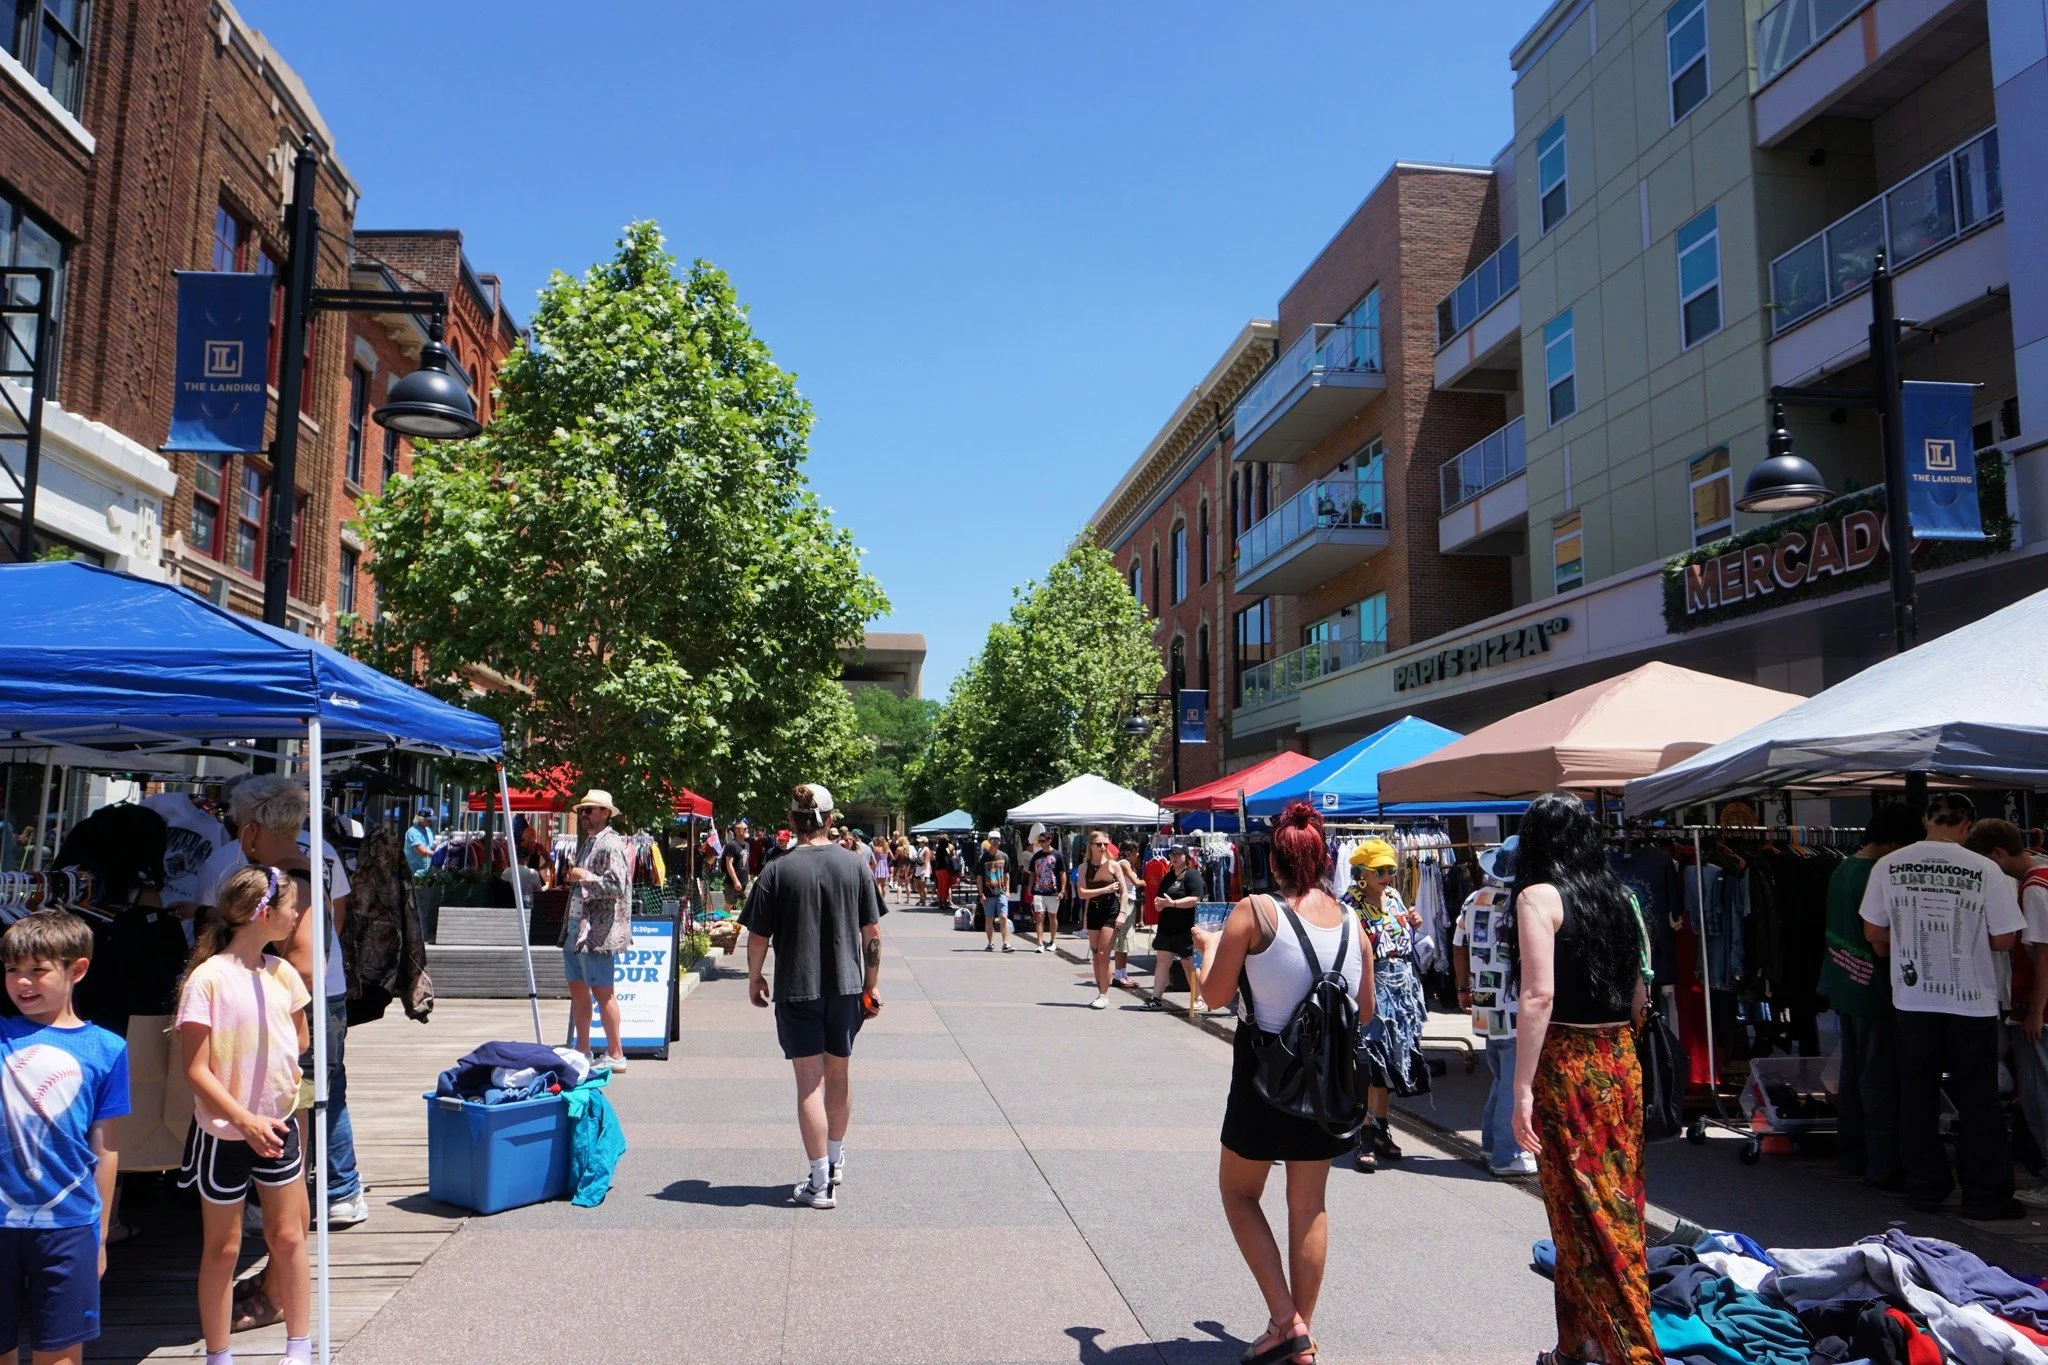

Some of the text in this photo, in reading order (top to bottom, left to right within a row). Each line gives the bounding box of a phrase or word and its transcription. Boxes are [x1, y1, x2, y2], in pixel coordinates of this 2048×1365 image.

[184, 382, 261, 393] THE LANDING
[1912, 473, 1972, 484] THE LANDING
[1394, 616, 1569, 692] PAPI'S PIZZA CO
[1889, 863, 1983, 882] CHROMAKOPIA
[1921, 886, 1944, 894] WORLD
[632, 926, 659, 934] 5:30pm
[614, 950, 666, 965] APPY
[614, 967, 659, 982] OUR
[616, 993, 636, 1001] OFF
